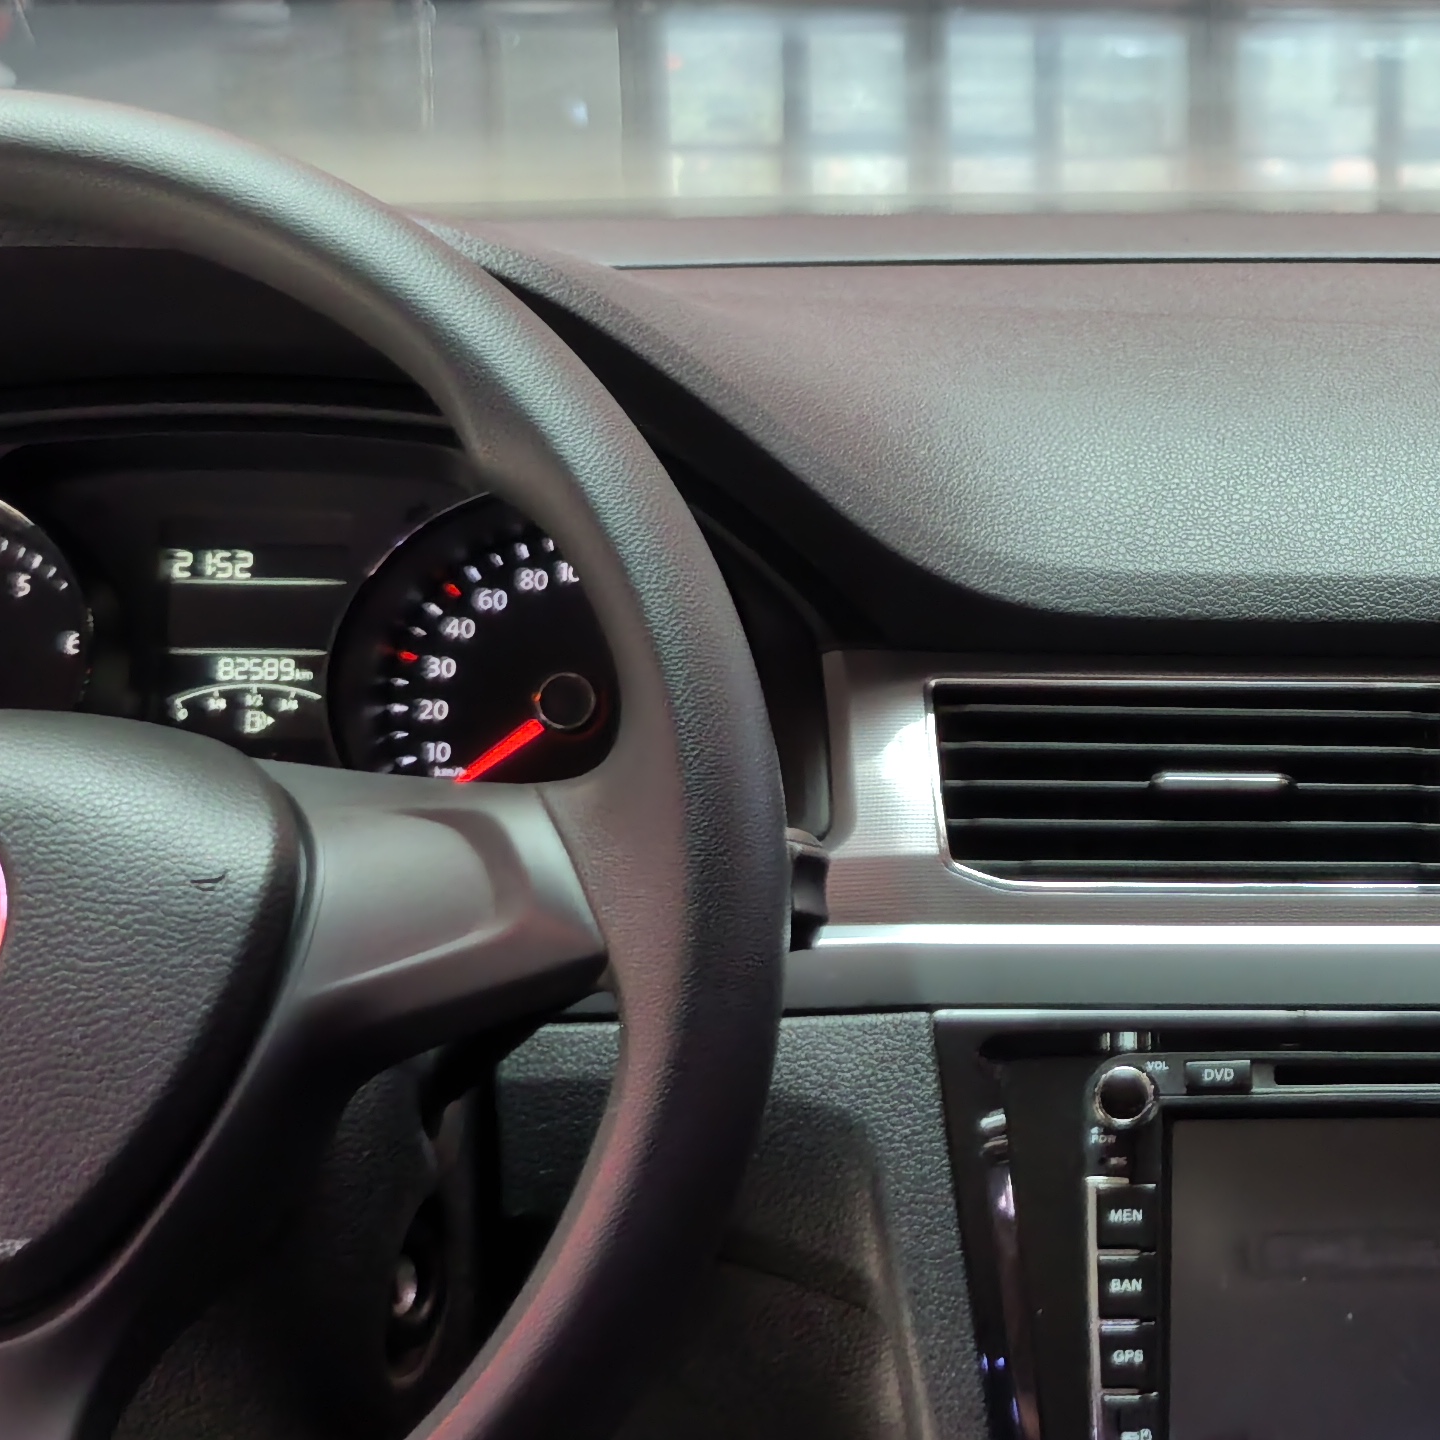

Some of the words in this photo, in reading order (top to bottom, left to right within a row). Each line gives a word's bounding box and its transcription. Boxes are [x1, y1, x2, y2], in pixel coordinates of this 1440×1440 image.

[517, 567, 549, 591] 80
[475, 588, 508, 611] 60
[443, 617, 476, 640] 40
[217, 657, 296, 681] 82589
[425, 656, 457, 680] 30
[418, 699, 449, 722] 20
[426, 742, 452, 763] 10
[1146, 1060, 1170, 1072] VOL
[1202, 1067, 1235, 1082] DVD
[1109, 1208, 1144, 1223] MEN
[1109, 1278, 1144, 1293] BAN
[1112, 1349, 1145, 1364] GPS
